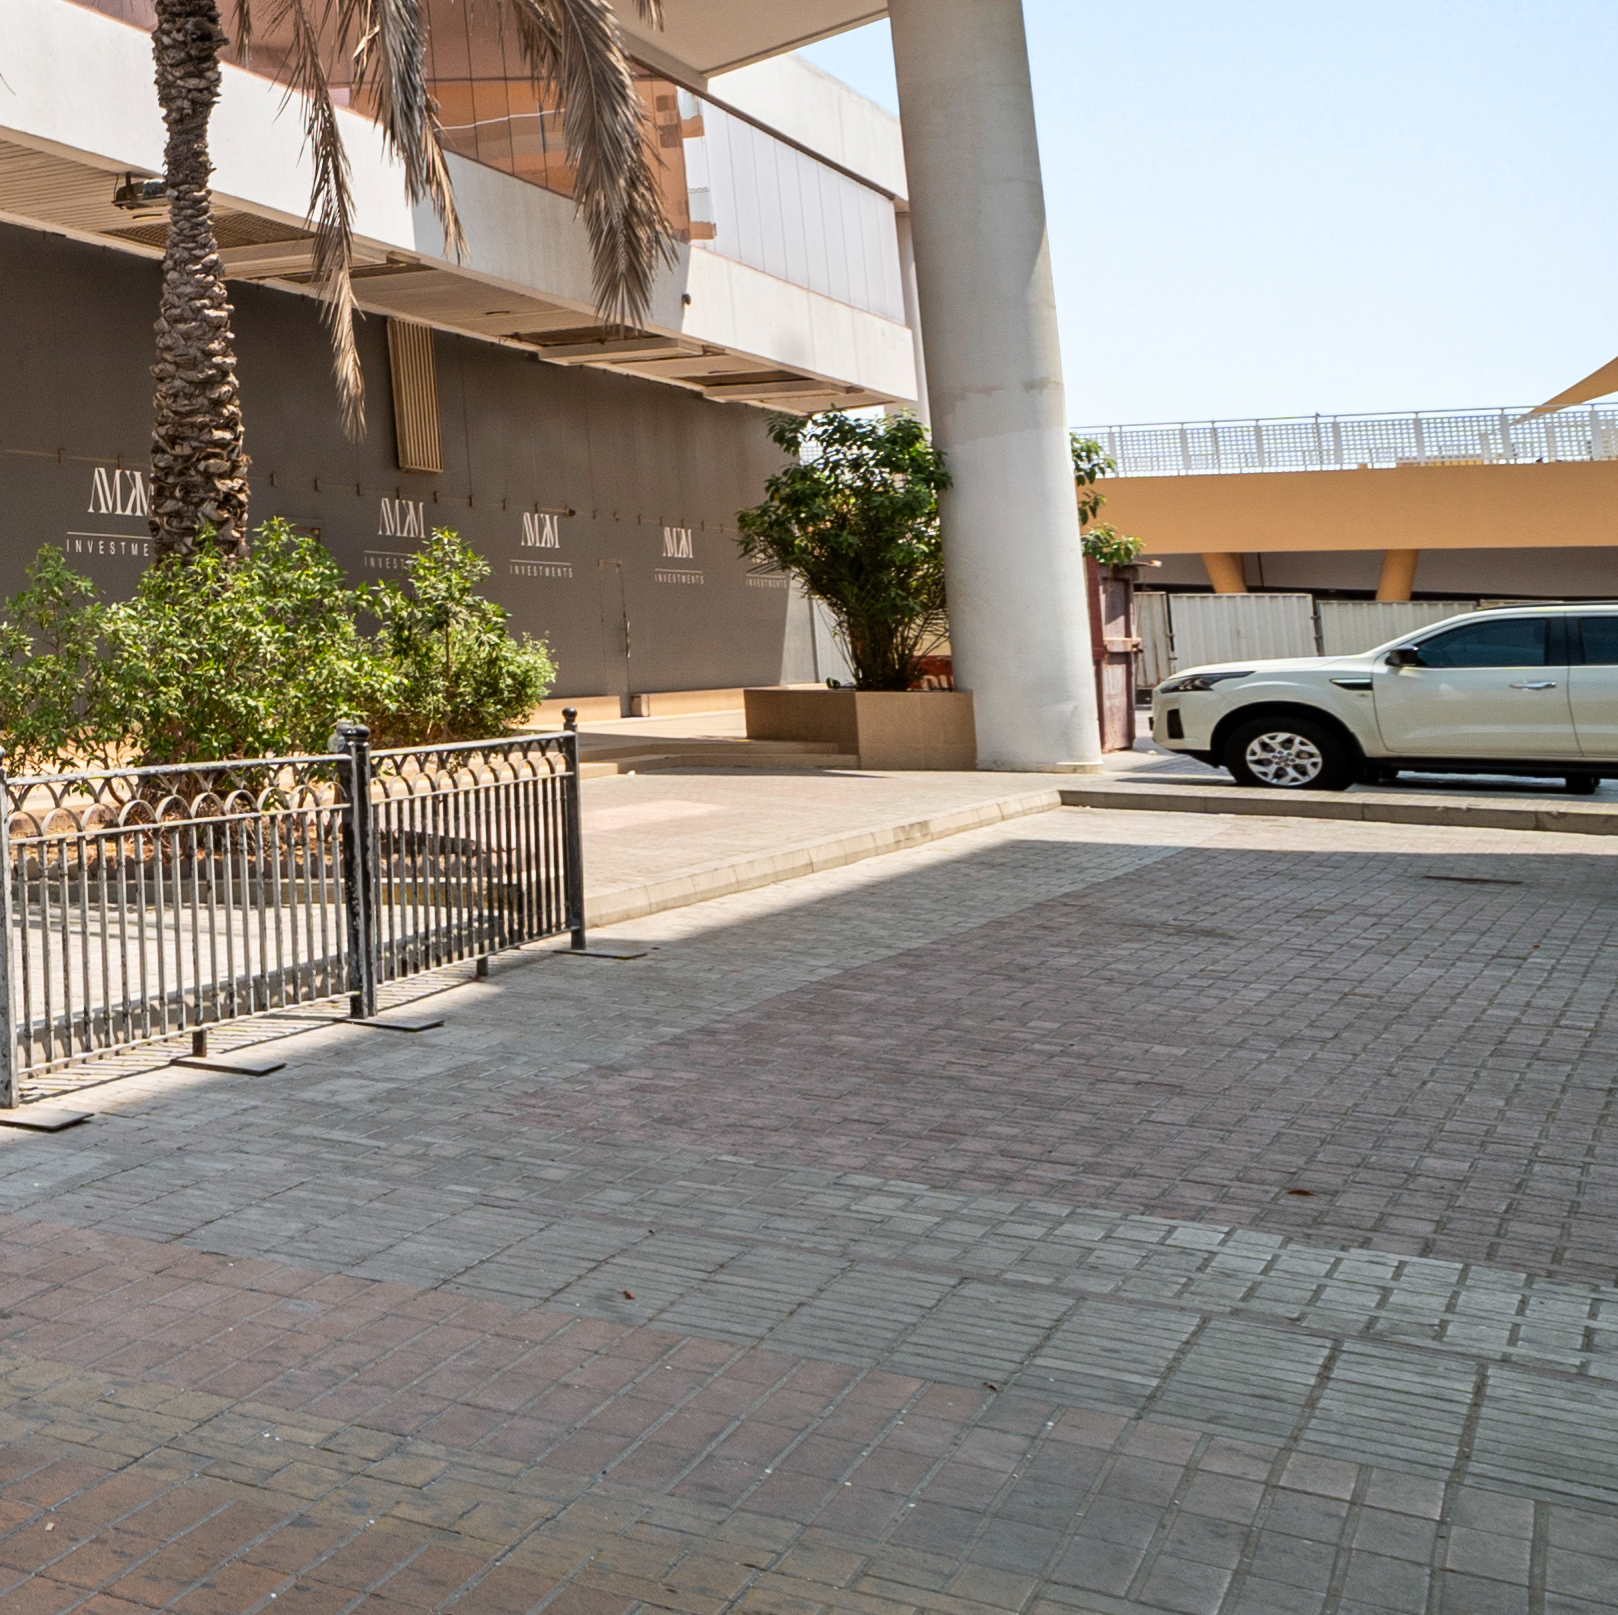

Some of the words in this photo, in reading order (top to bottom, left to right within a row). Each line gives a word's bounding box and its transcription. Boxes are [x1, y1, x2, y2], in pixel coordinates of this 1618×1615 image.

[66, 539, 149, 557] INVESTME
[364, 555, 406, 570] INVEST
[509, 565, 573, 578] INVESTMENTS
[654, 573, 704, 585] INVESTMENTS
